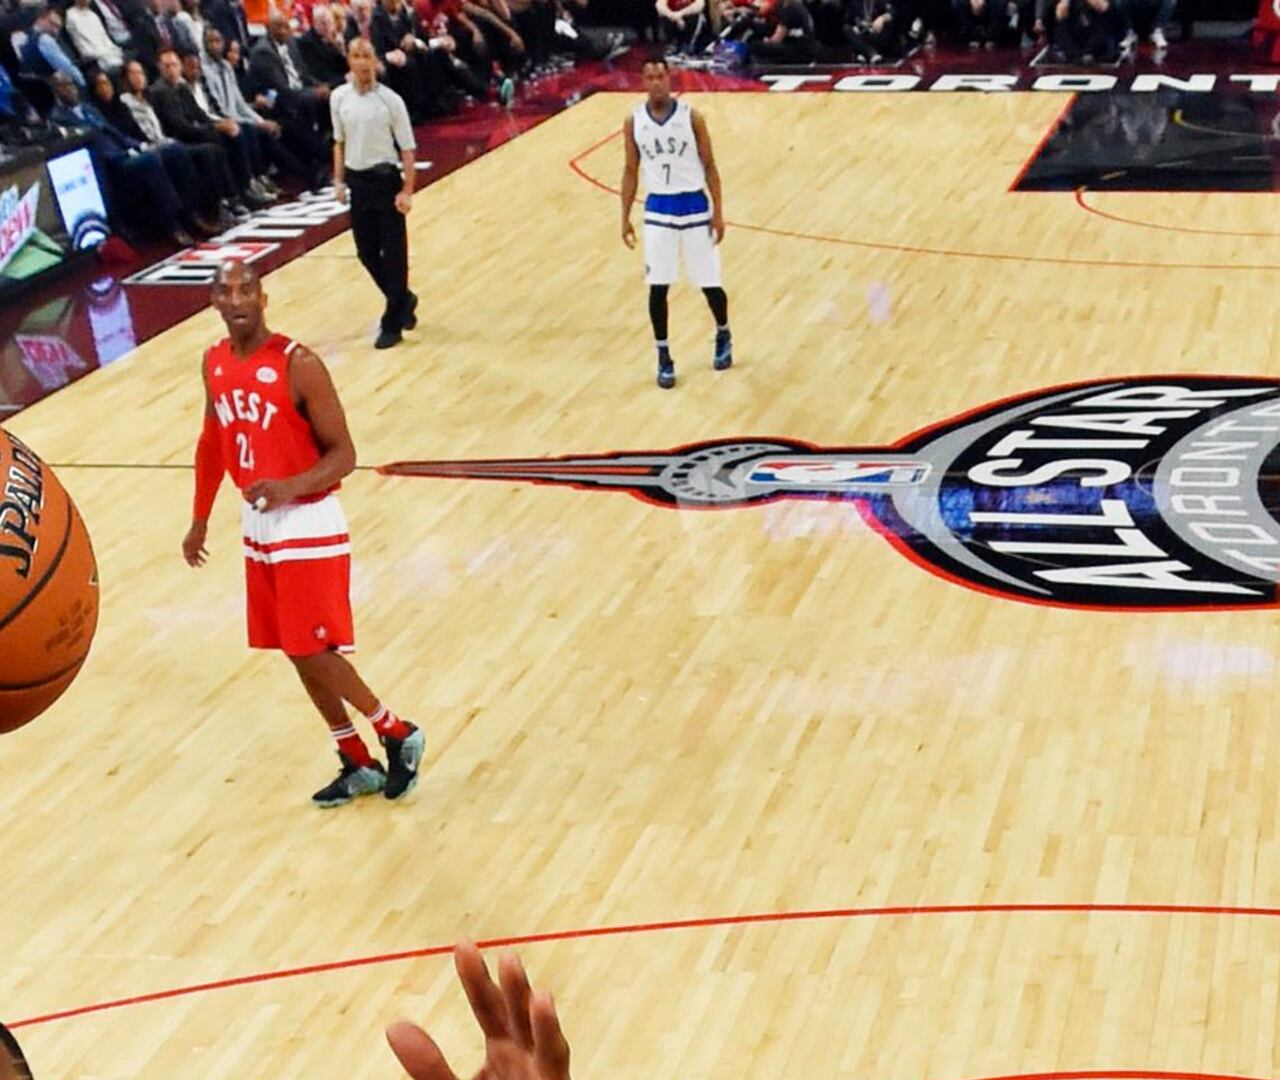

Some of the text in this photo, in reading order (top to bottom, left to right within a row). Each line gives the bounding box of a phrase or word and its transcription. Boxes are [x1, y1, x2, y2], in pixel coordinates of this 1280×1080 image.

[641, 136, 688, 160] EAST
[662, 163, 671, 186] 7
[214, 389, 278, 430] WEST
[968, 384, 1278, 597] ALL STAR
